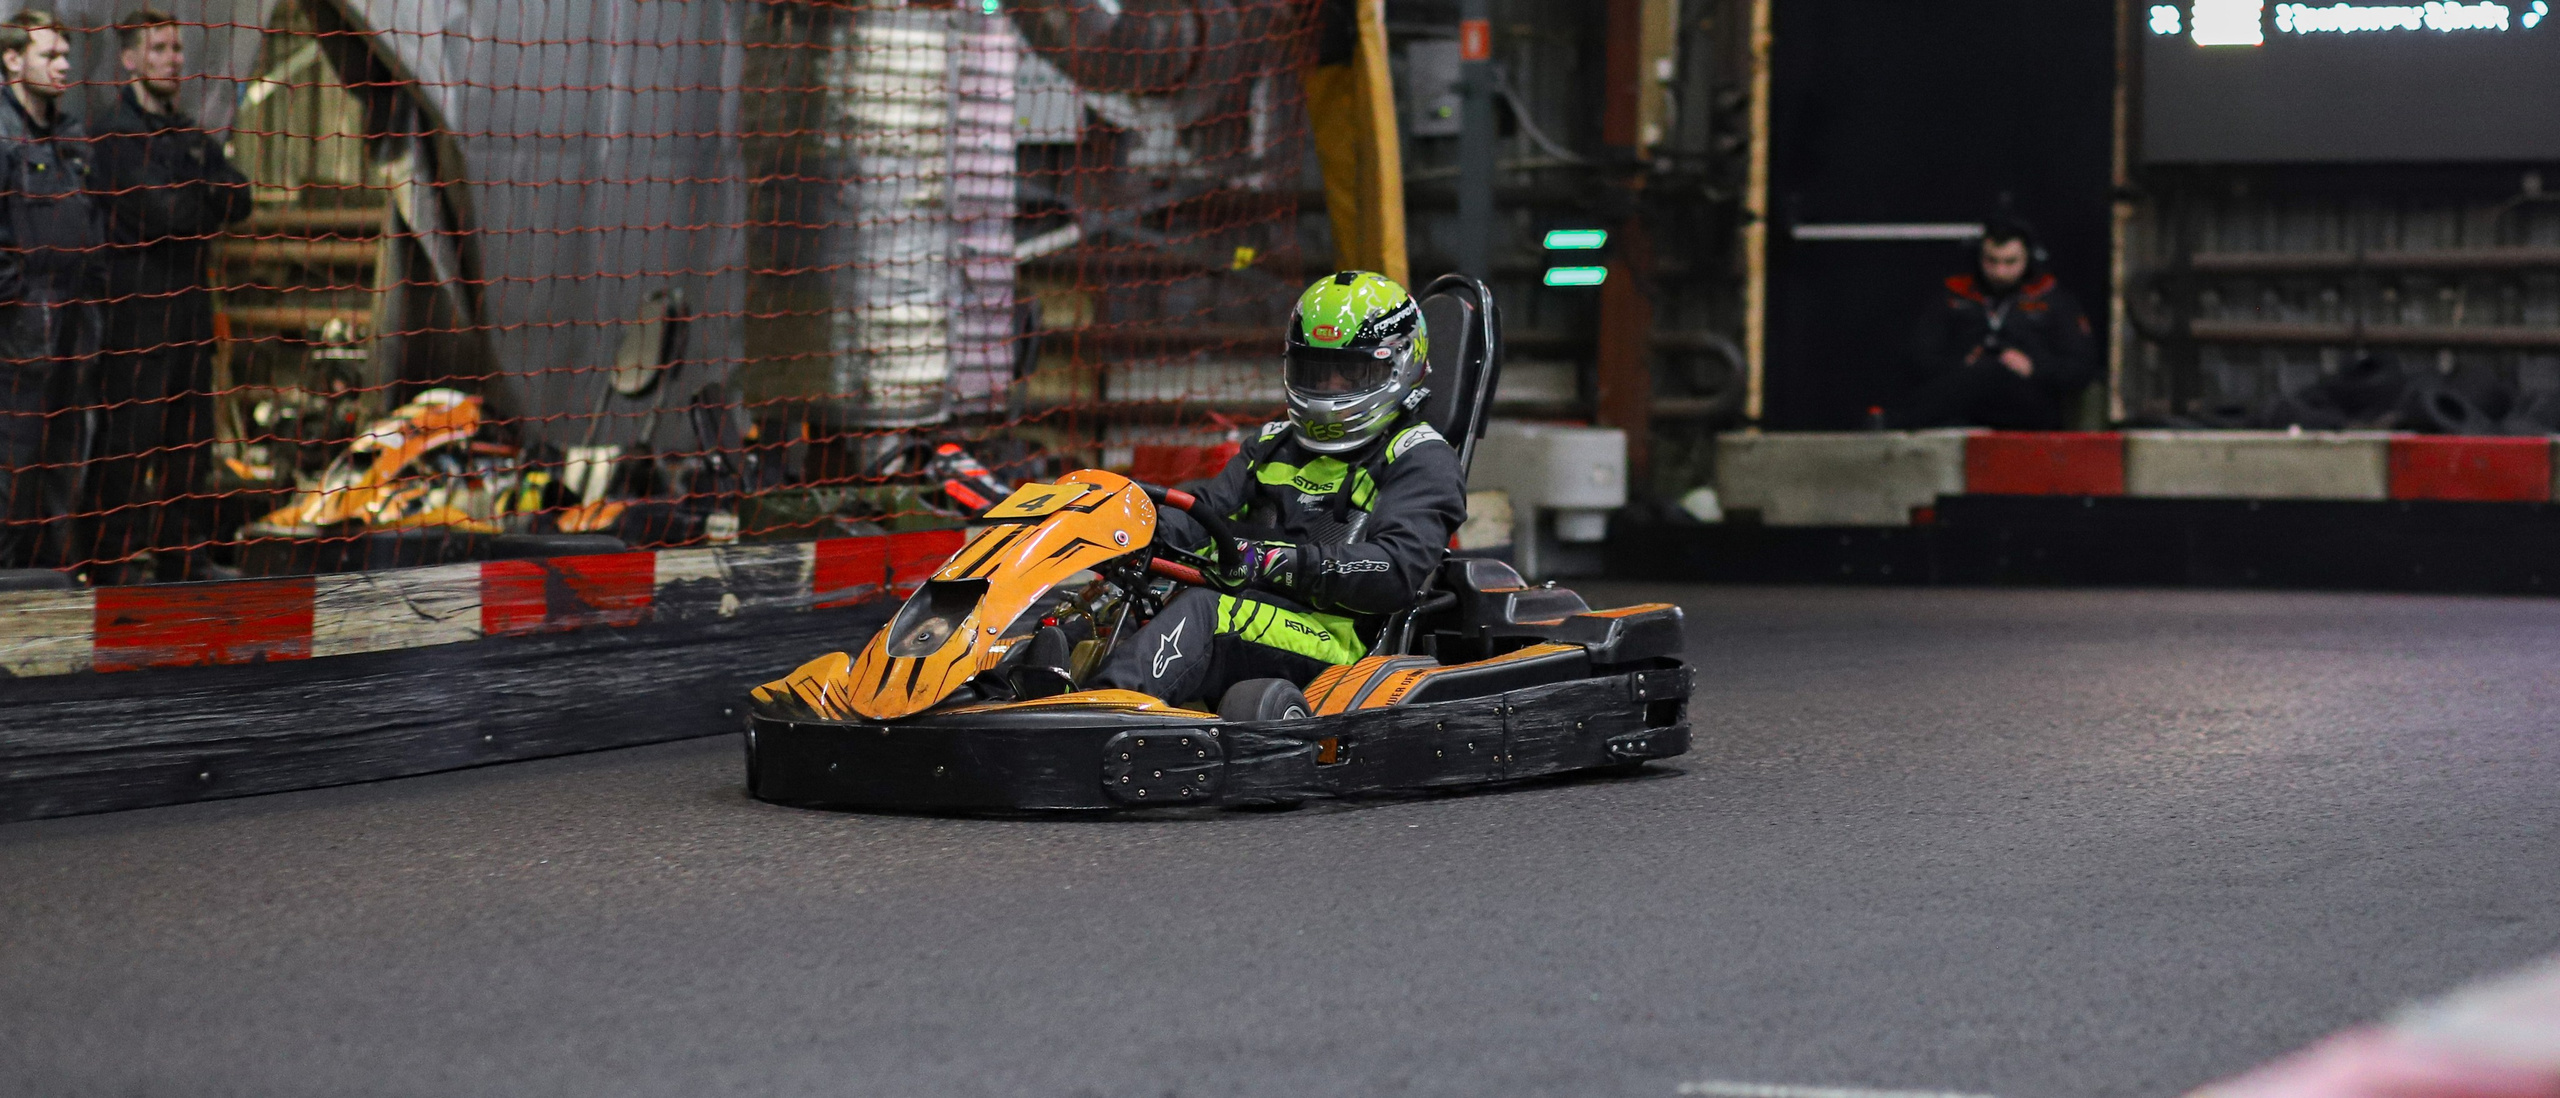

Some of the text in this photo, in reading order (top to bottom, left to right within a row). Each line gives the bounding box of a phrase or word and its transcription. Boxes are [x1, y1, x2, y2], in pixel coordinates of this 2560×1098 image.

[1301, 420, 1345, 441] YES
[1015, 493, 1057, 512] 4
[1284, 618, 1331, 641] ASTAS
